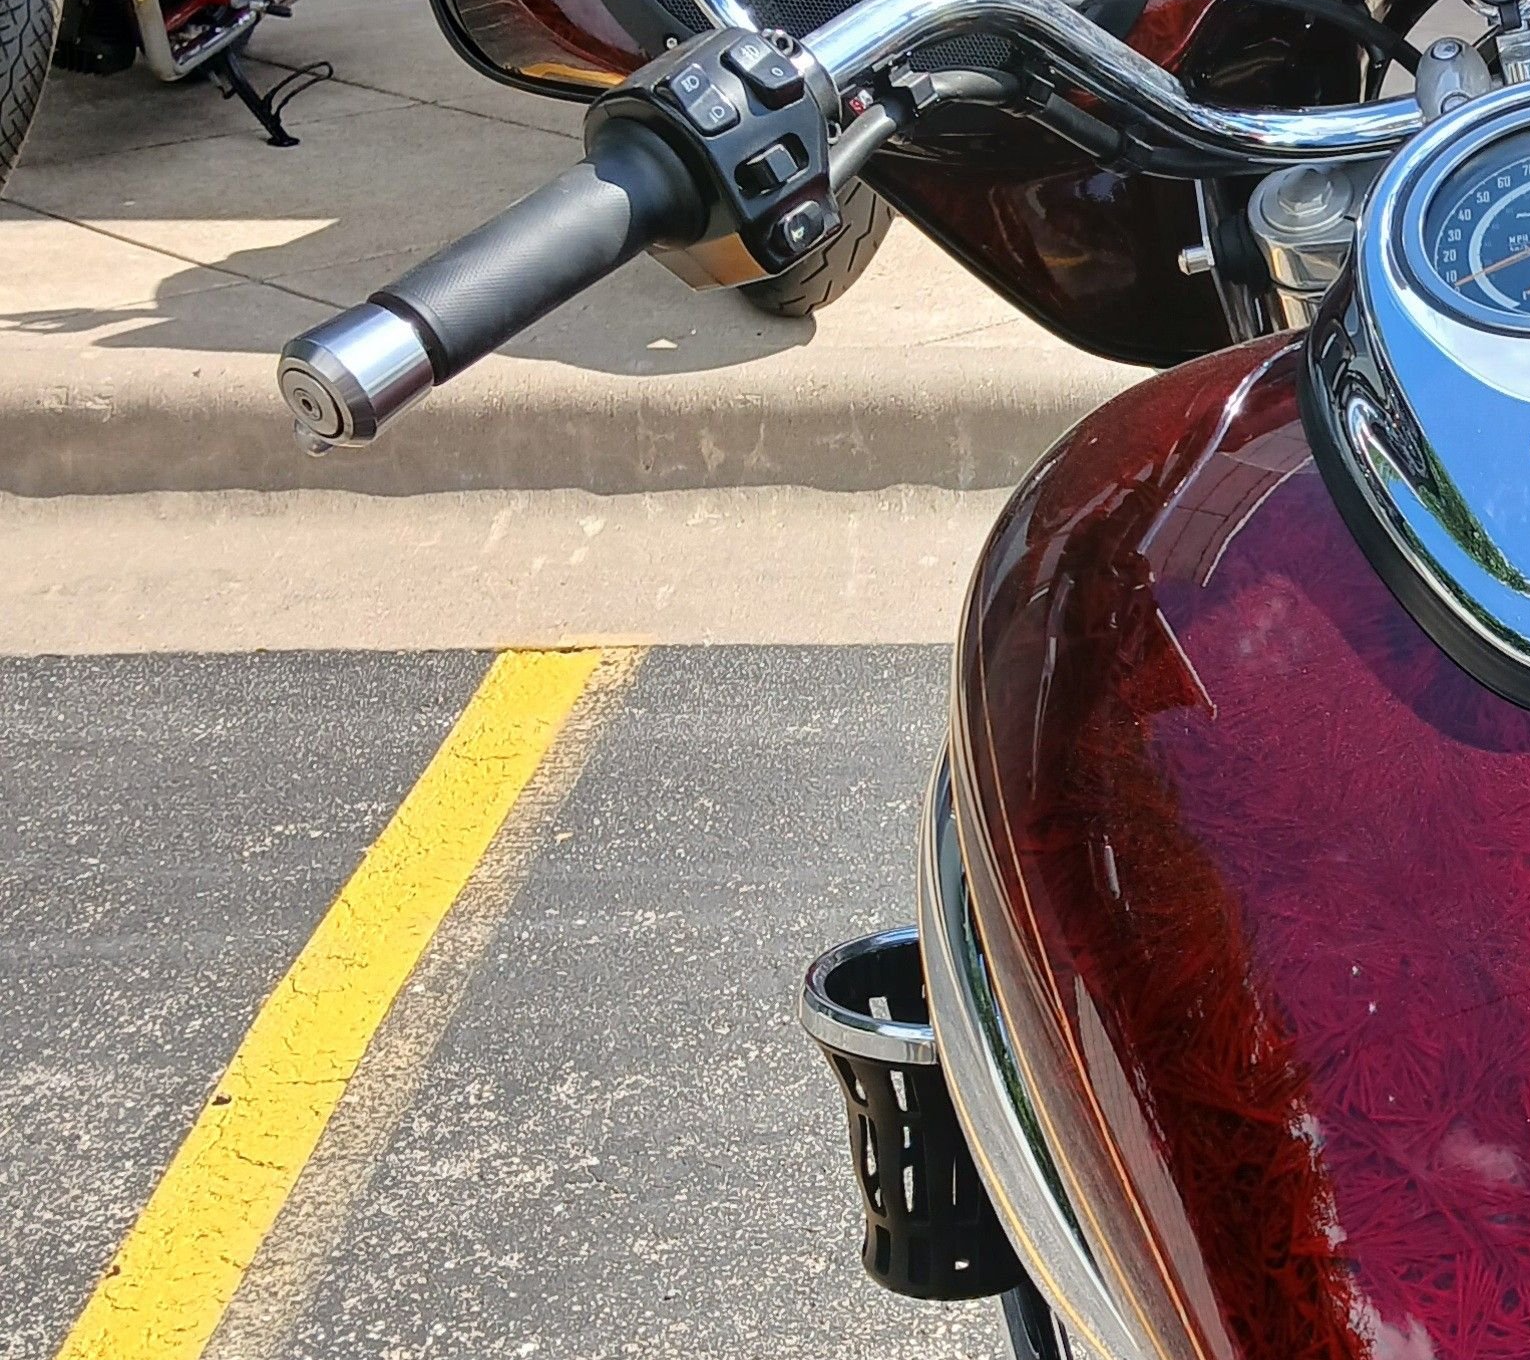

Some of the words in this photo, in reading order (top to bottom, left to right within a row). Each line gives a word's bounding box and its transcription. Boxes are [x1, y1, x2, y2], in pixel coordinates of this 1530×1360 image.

[1497, 176, 1511, 188] 60
[1476, 191, 1490, 203] 50
[1458, 209, 1471, 221] 40
[1448, 229, 1461, 241] 30
[1443, 249, 1456, 262] 20
[1446, 270, 1457, 282] 10
